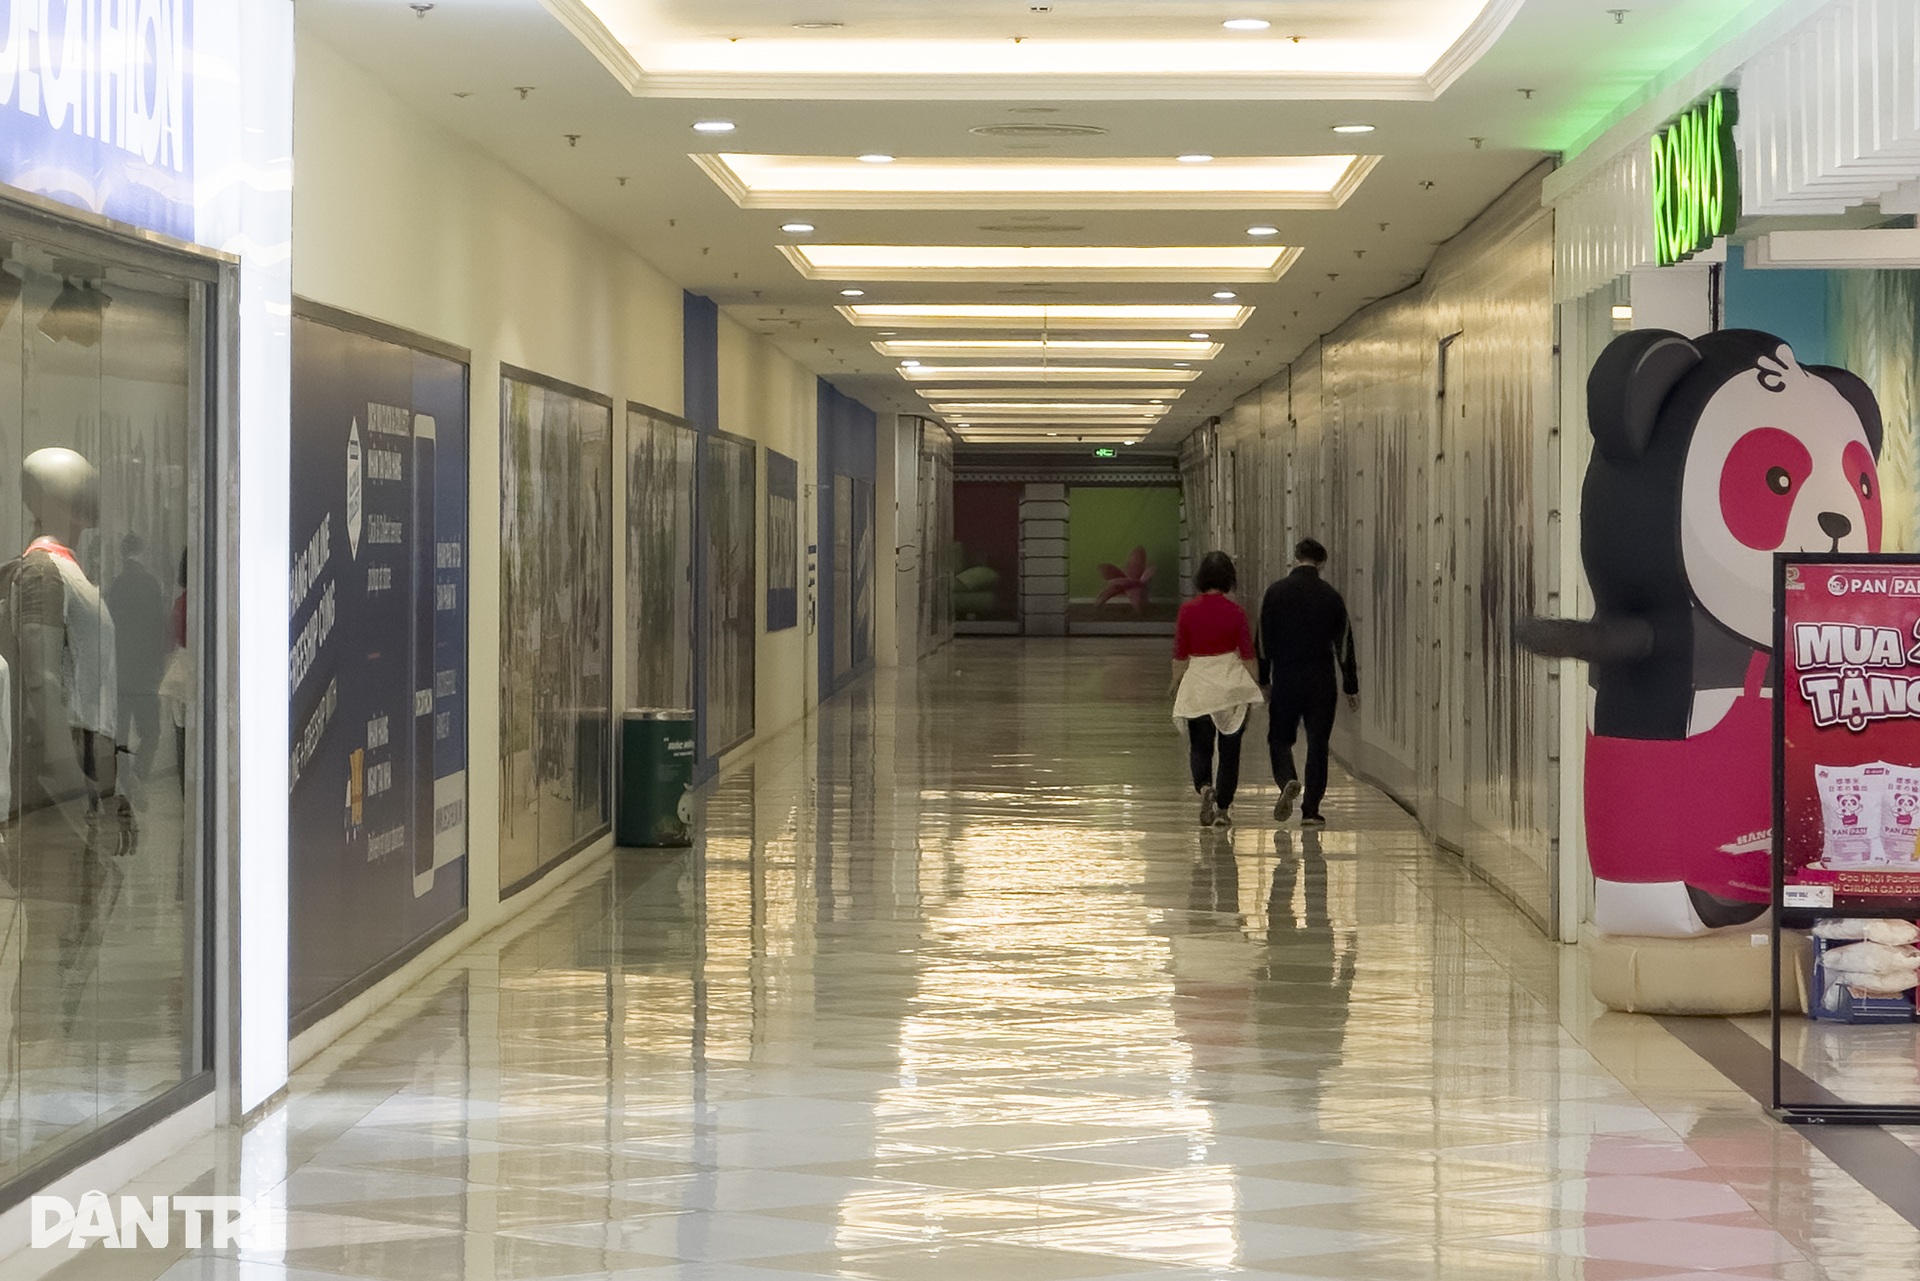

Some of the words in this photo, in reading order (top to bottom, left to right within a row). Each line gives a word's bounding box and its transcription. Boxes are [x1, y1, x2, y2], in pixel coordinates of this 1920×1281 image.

[1851, 579, 1887, 593] PAN
[1894, 579, 1920, 593] PA
[1797, 624, 1902, 667] MUA
[1906, 885, 1920, 895] XU
